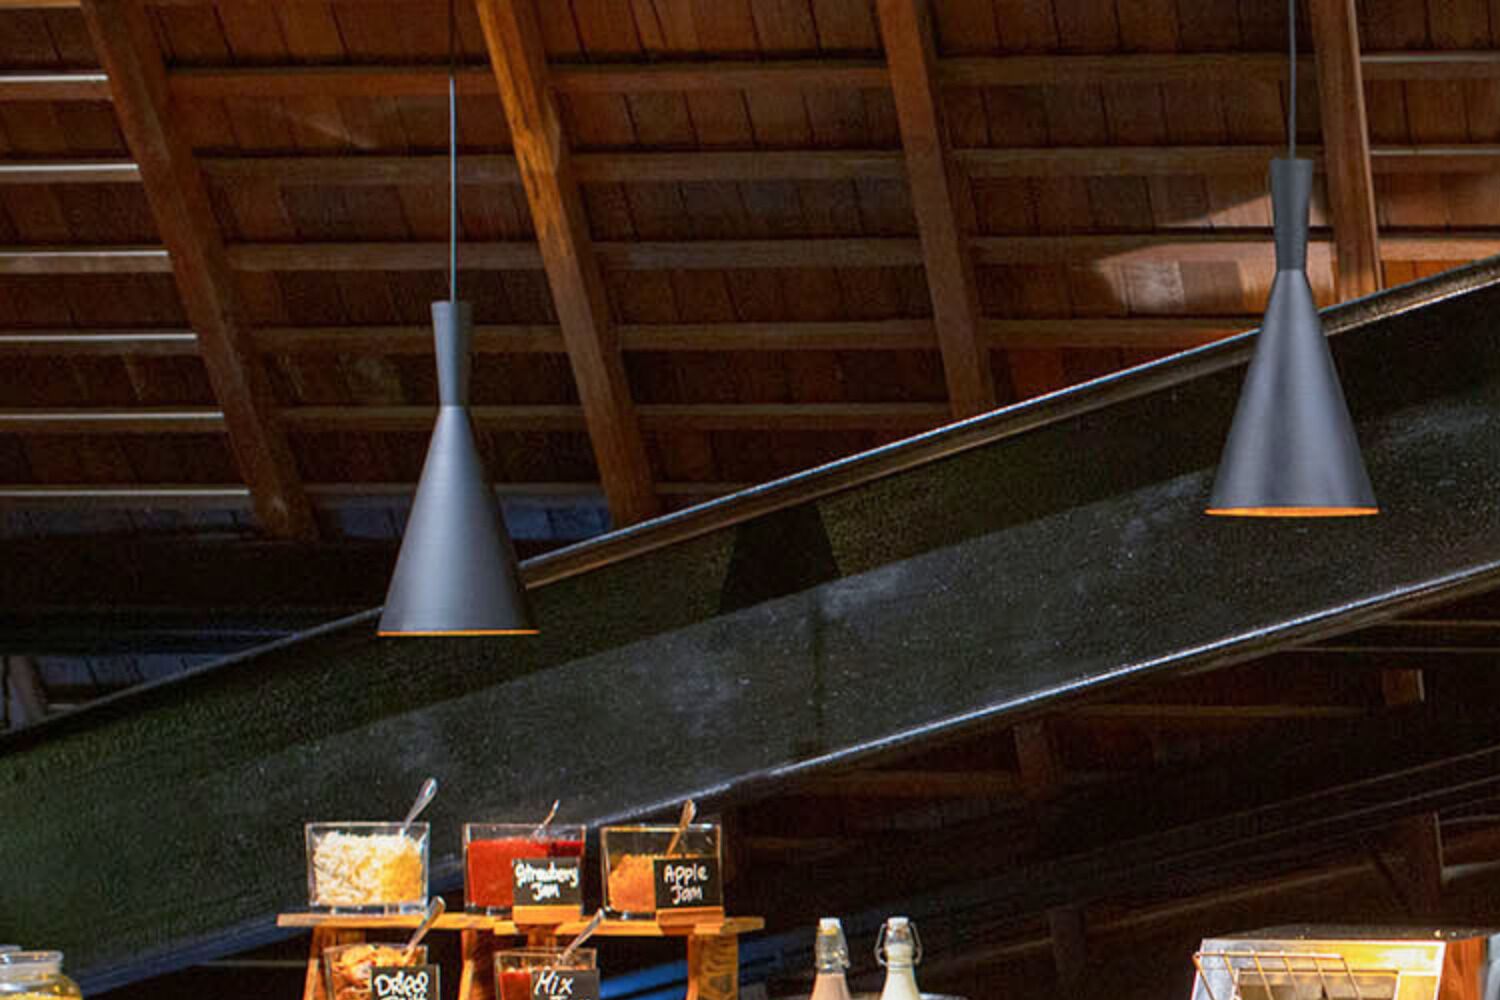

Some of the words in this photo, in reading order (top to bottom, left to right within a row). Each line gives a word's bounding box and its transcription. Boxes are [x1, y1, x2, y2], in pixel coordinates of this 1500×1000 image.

[664, 863, 709, 886] Apple
[530, 882, 560, 902] Jam
[671, 885, 703, 905] Jam
[534, 966, 574, 995] Mix
